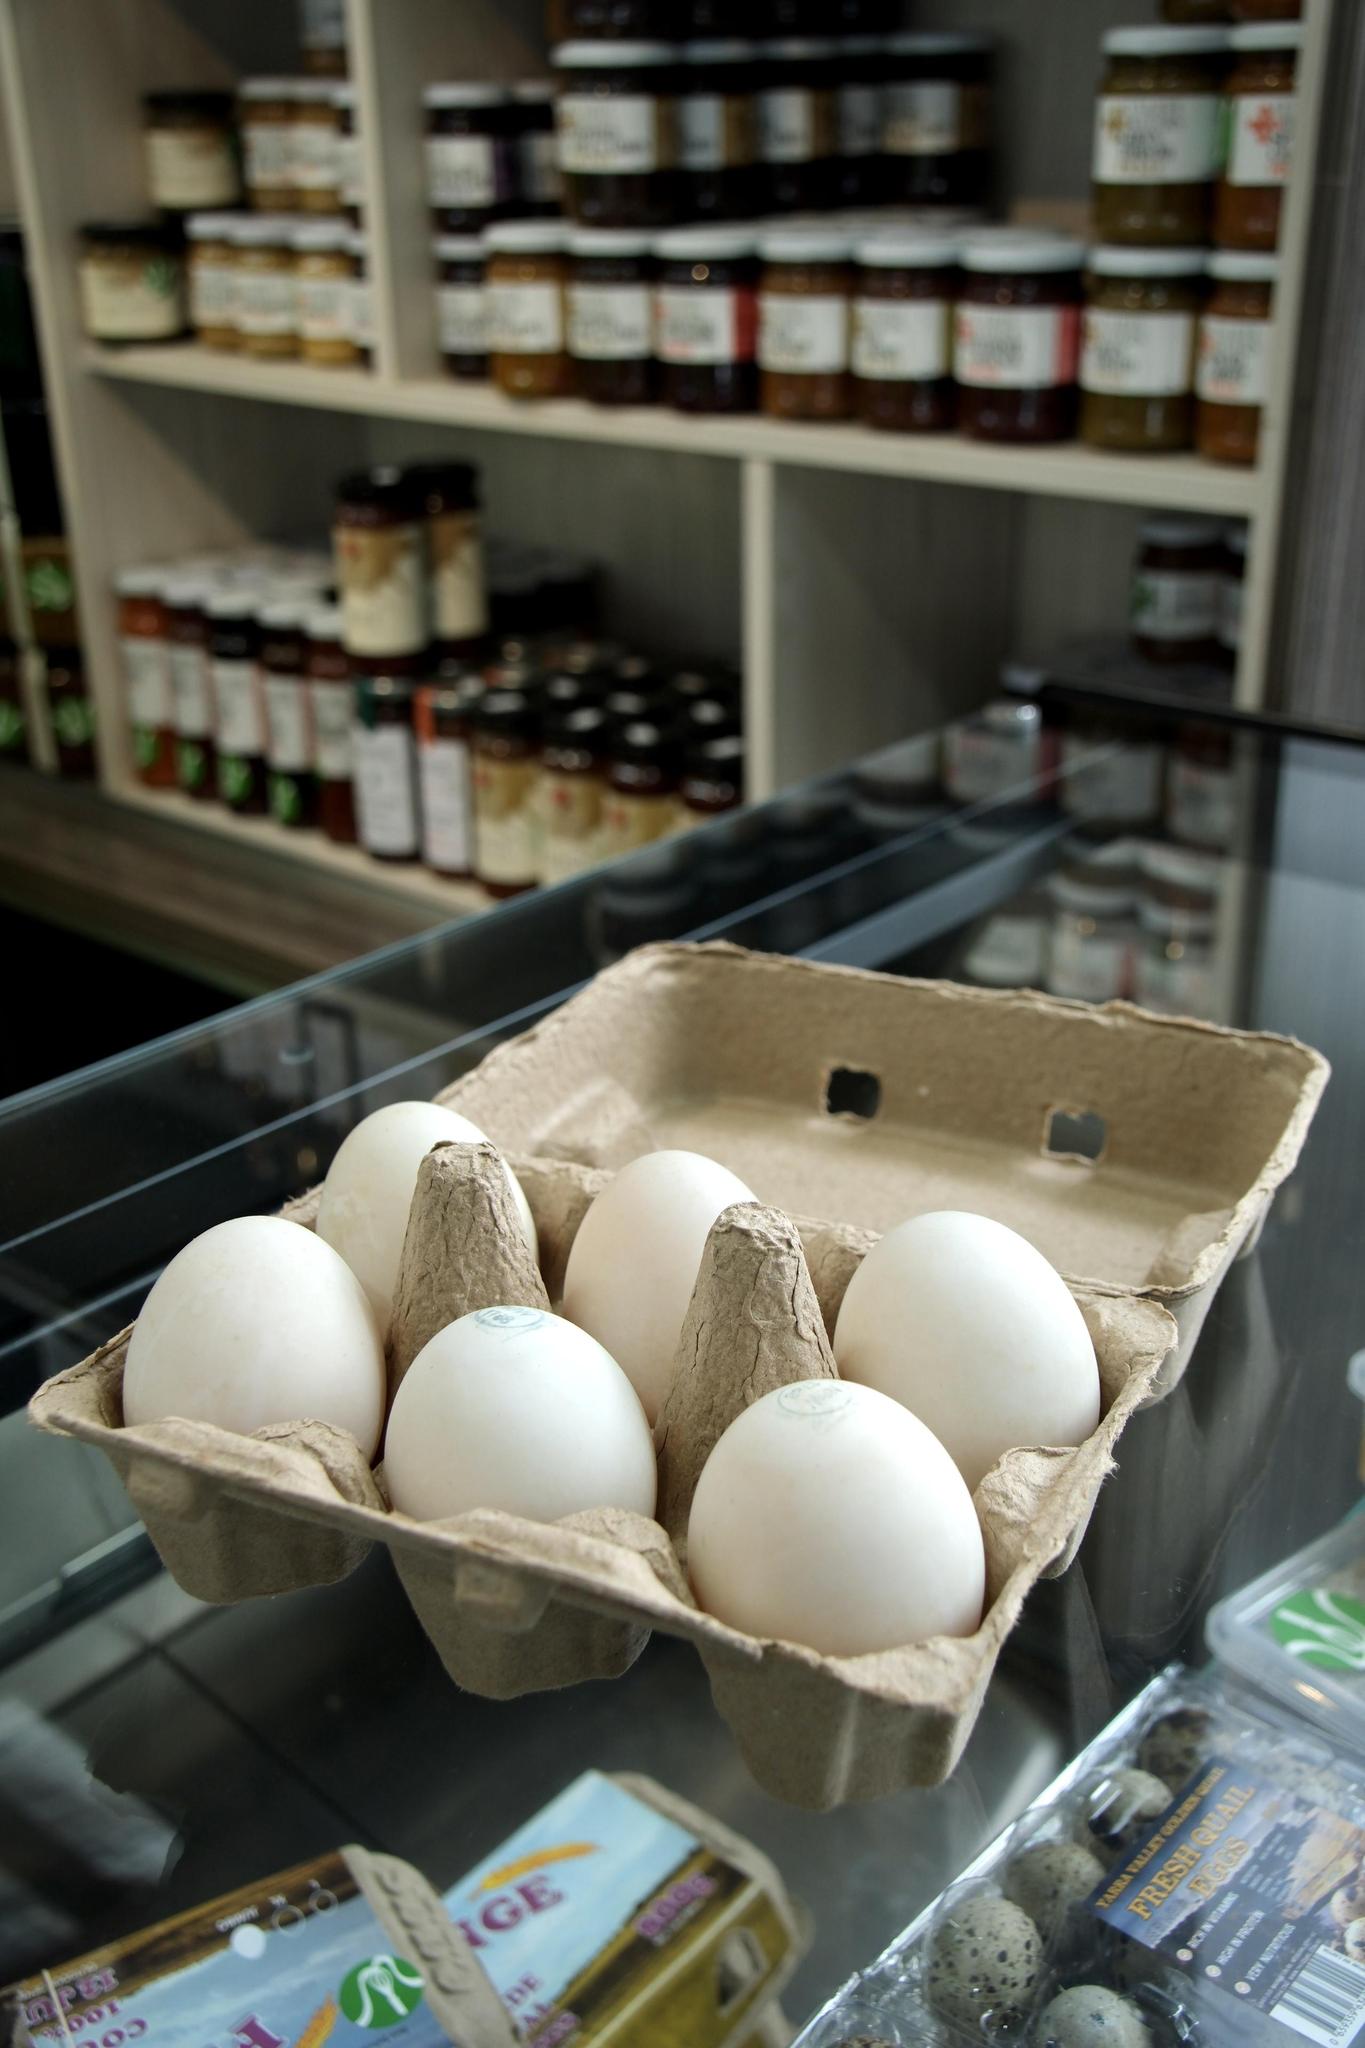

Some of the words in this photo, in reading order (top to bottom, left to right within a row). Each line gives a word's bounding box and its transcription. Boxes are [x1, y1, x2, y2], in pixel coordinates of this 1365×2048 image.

[1126, 1833, 1166, 1874] VALLEY
[1128, 1844, 1202, 1921] FRESH
[1191, 1786, 1257, 1847] QUAIL
[1188, 1836, 1249, 1900] EGGS
